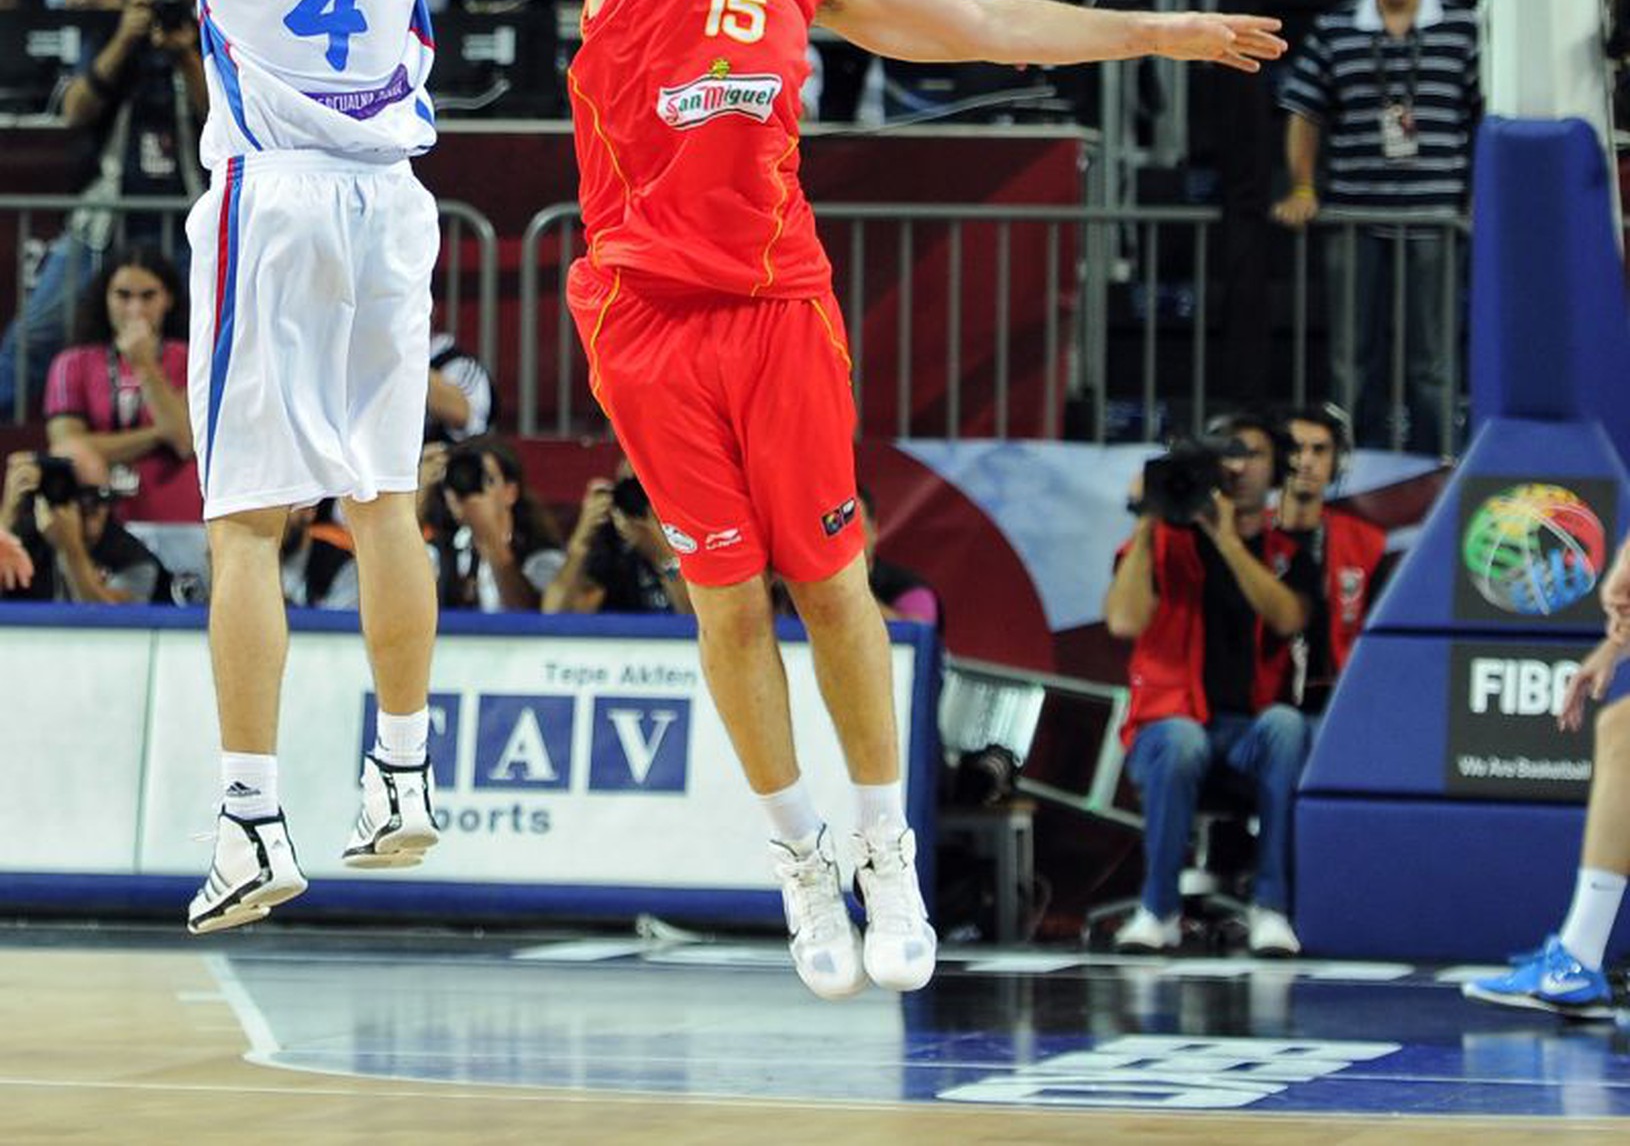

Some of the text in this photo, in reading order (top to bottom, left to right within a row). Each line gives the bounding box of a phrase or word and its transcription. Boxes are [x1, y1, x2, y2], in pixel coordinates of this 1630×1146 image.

[666, 84, 775, 124] San Miguel
[544, 661, 608, 686] Tepe
